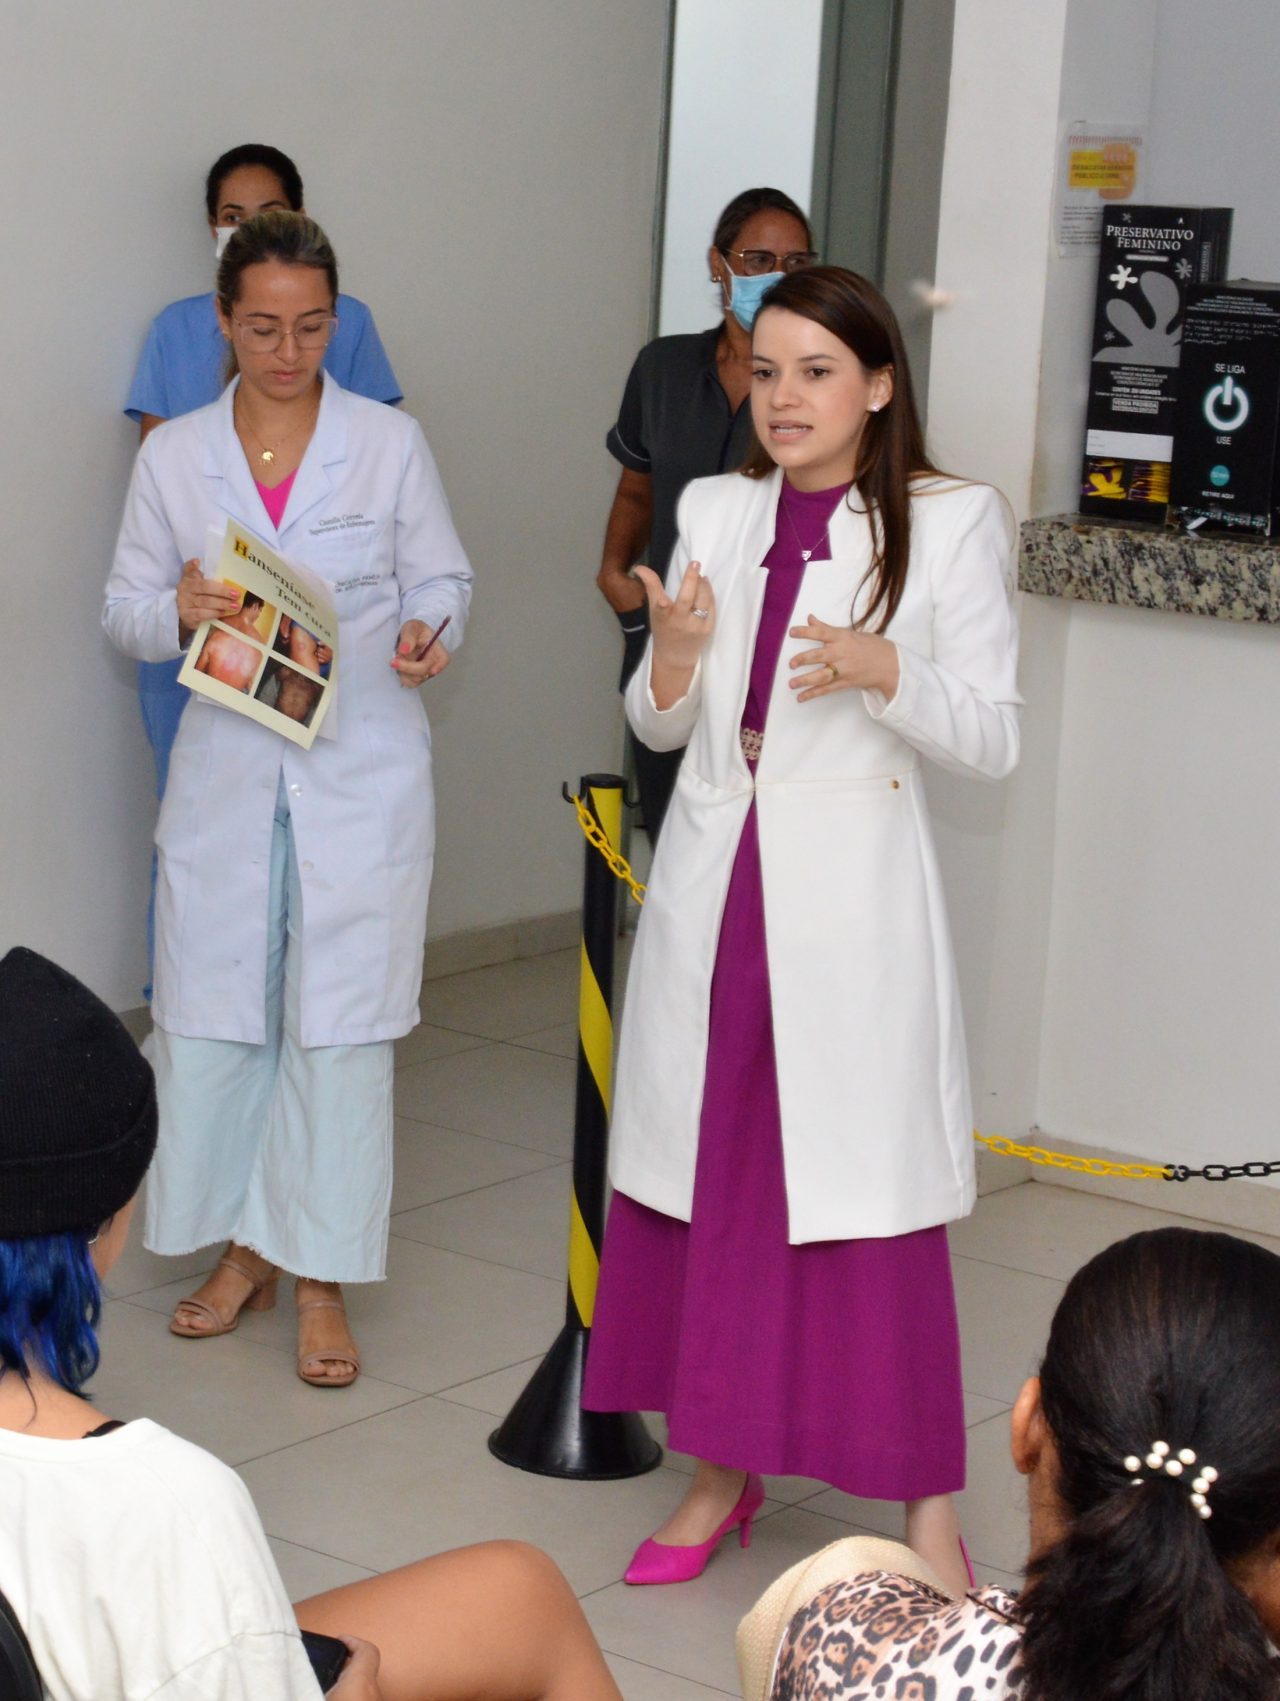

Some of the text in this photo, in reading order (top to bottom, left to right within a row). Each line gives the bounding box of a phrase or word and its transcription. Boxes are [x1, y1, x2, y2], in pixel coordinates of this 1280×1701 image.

[1106, 225, 1194, 240] PRESERVATIVO
[1117, 237, 1181, 251] FEMININO
[1214, 363, 1246, 375] SE LIGA
[1216, 435, 1232, 446] USE
[234, 539, 316, 610] Hanseníase
[276, 585, 332, 638] Tem cura
